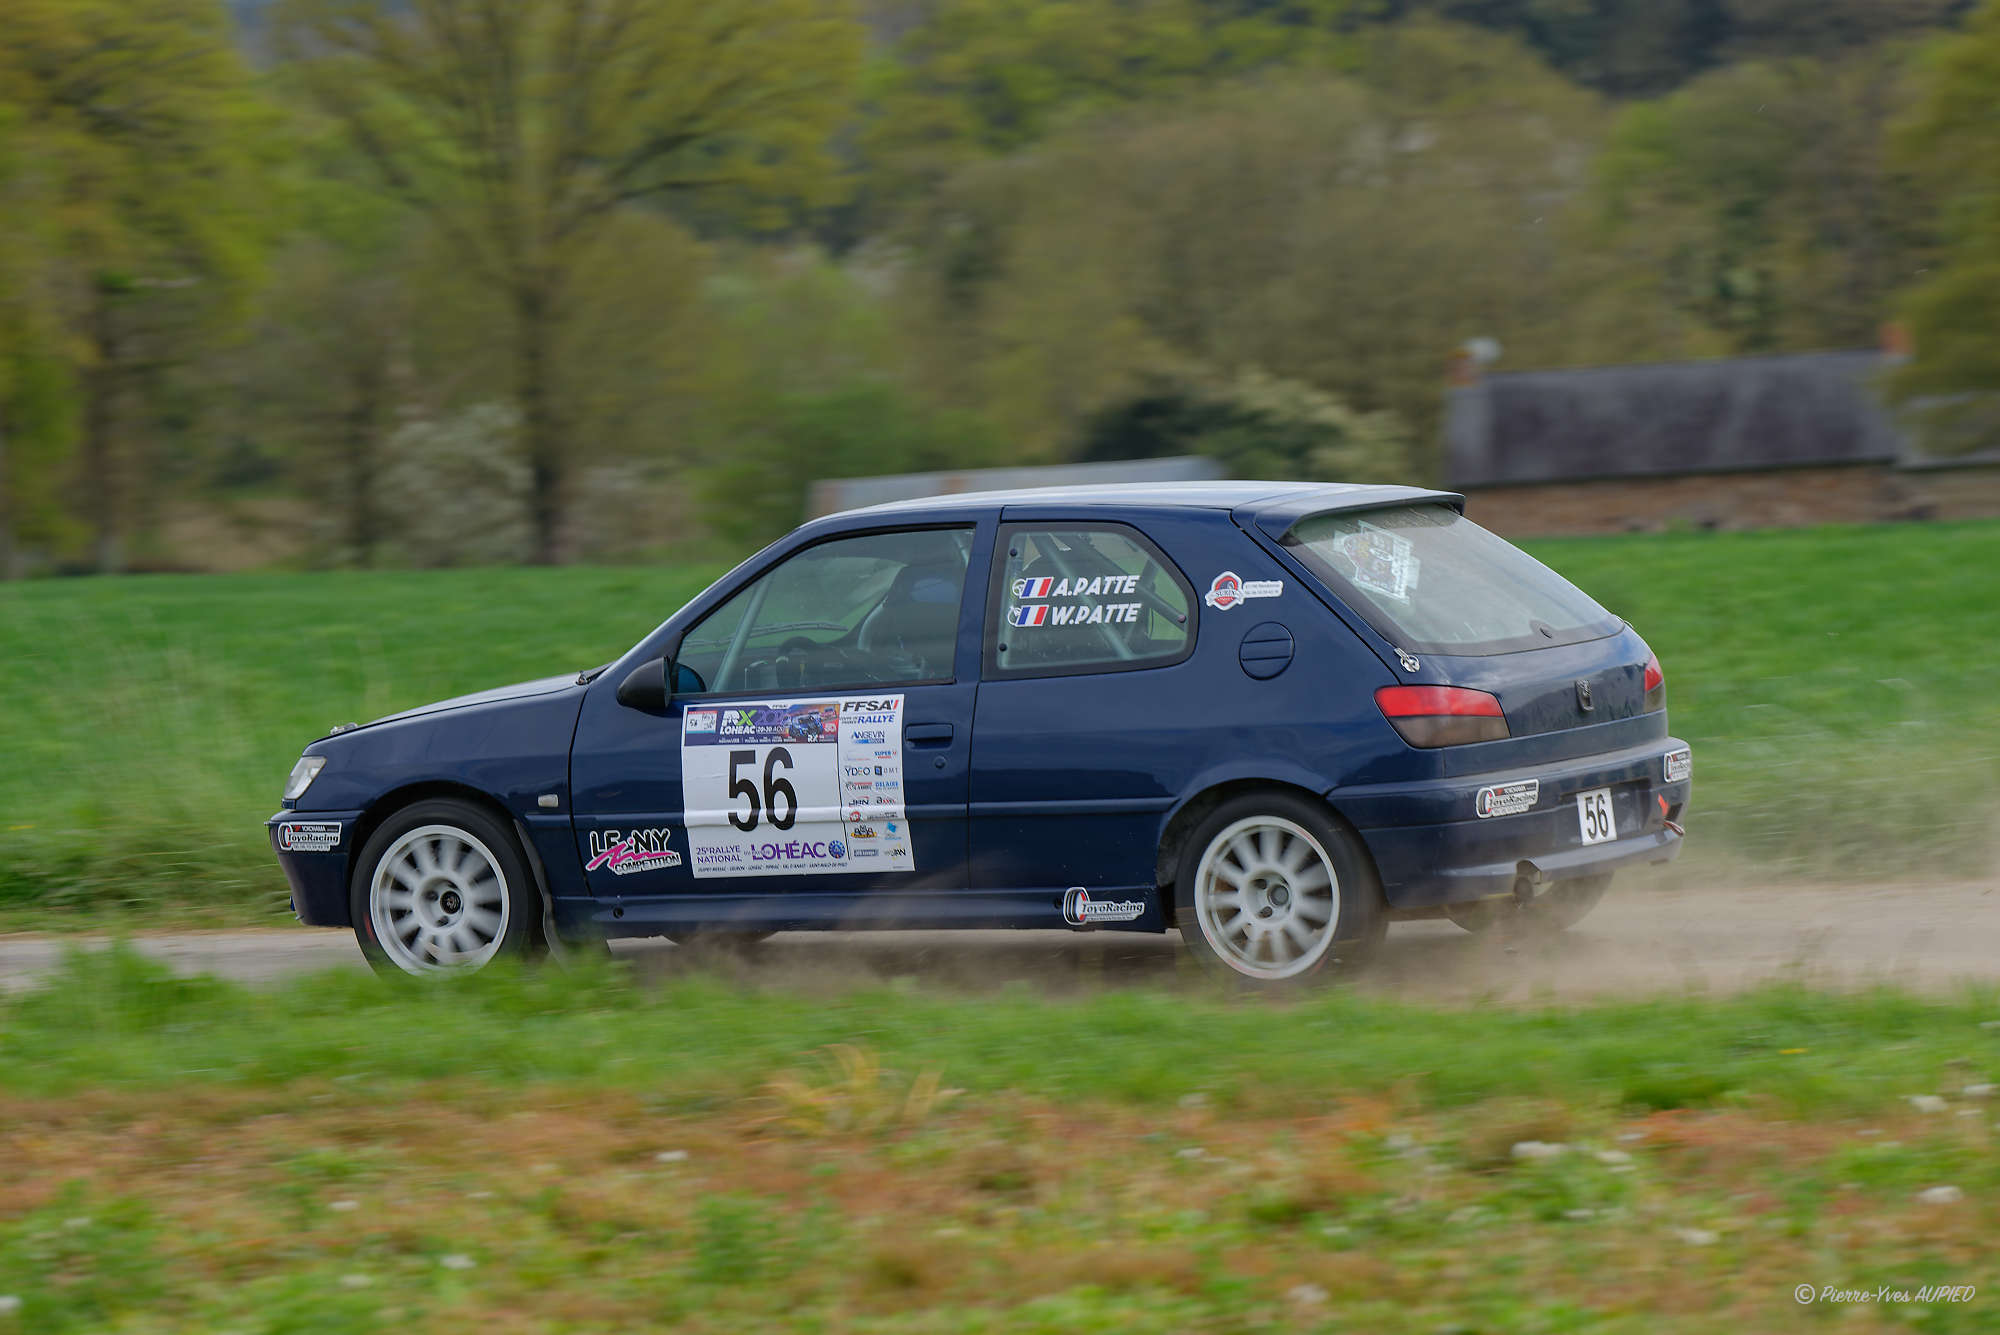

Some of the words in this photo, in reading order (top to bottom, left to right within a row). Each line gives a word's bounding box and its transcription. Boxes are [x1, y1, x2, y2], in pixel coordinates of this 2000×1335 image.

[1052, 575, 1140, 597] A.PATTE
[1051, 603, 1142, 625] W.PATTE
[843, 700, 892, 712] FFSA
[857, 714, 895, 724] RALLYE
[719, 725, 756, 735] LOHEAC
[728, 747, 797, 831] 56
[1585, 793, 1608, 840] 56
[288, 833, 338, 842] ToyoRacing
[709, 844, 741, 854] RALLYE
[751, 840, 826, 860] LOHÉAC
[615, 855, 679, 872] COMPETITION
[697, 854, 742, 864] NATIONAL
[1083, 903, 1142, 913] ToyoRacing
